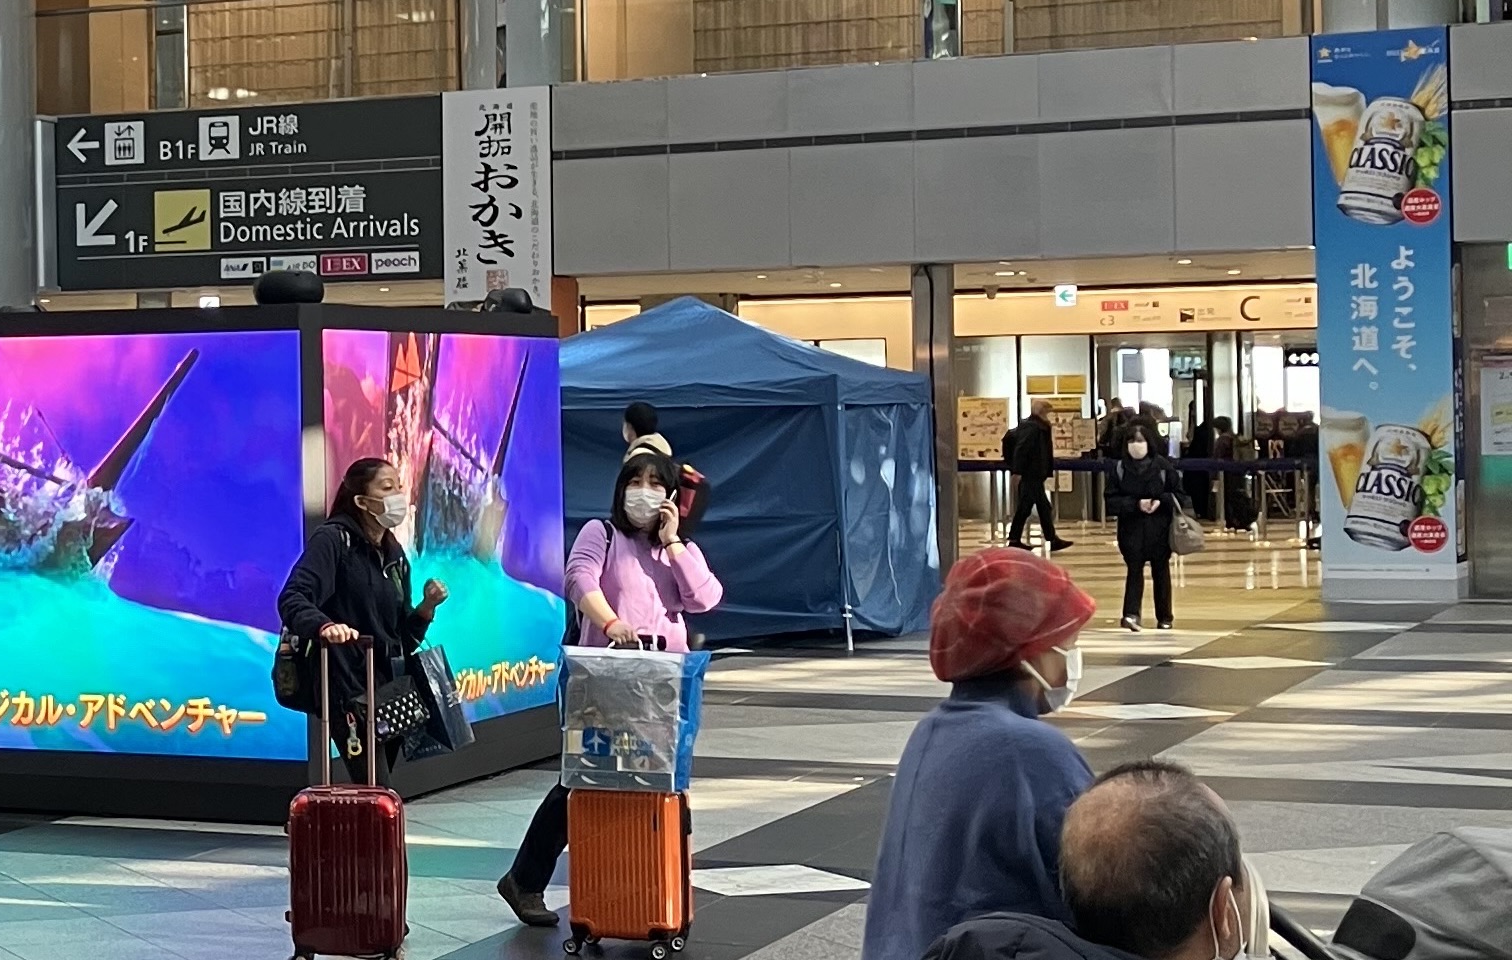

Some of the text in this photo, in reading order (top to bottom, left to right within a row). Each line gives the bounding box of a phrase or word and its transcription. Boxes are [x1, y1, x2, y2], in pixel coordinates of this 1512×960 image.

[248, 114, 299, 136] JR線
[159, 140, 197, 161] B1F
[248, 140, 307, 156] JR Train
[1349, 147, 1417, 179] CLASSIC
[219, 185, 367, 218] 国内線到着
[469, 111, 522, 265] 開拓おかき
[125, 230, 148, 253] 1F
[220, 213, 420, 243] Domestic Arrivals
[1240, 295, 1261, 322] C
[1390, 245, 1417, 371] ようこそ、
[1350, 263, 1379, 391] 北海道へ。
[1355, 470, 1427, 507] CLASSIC
